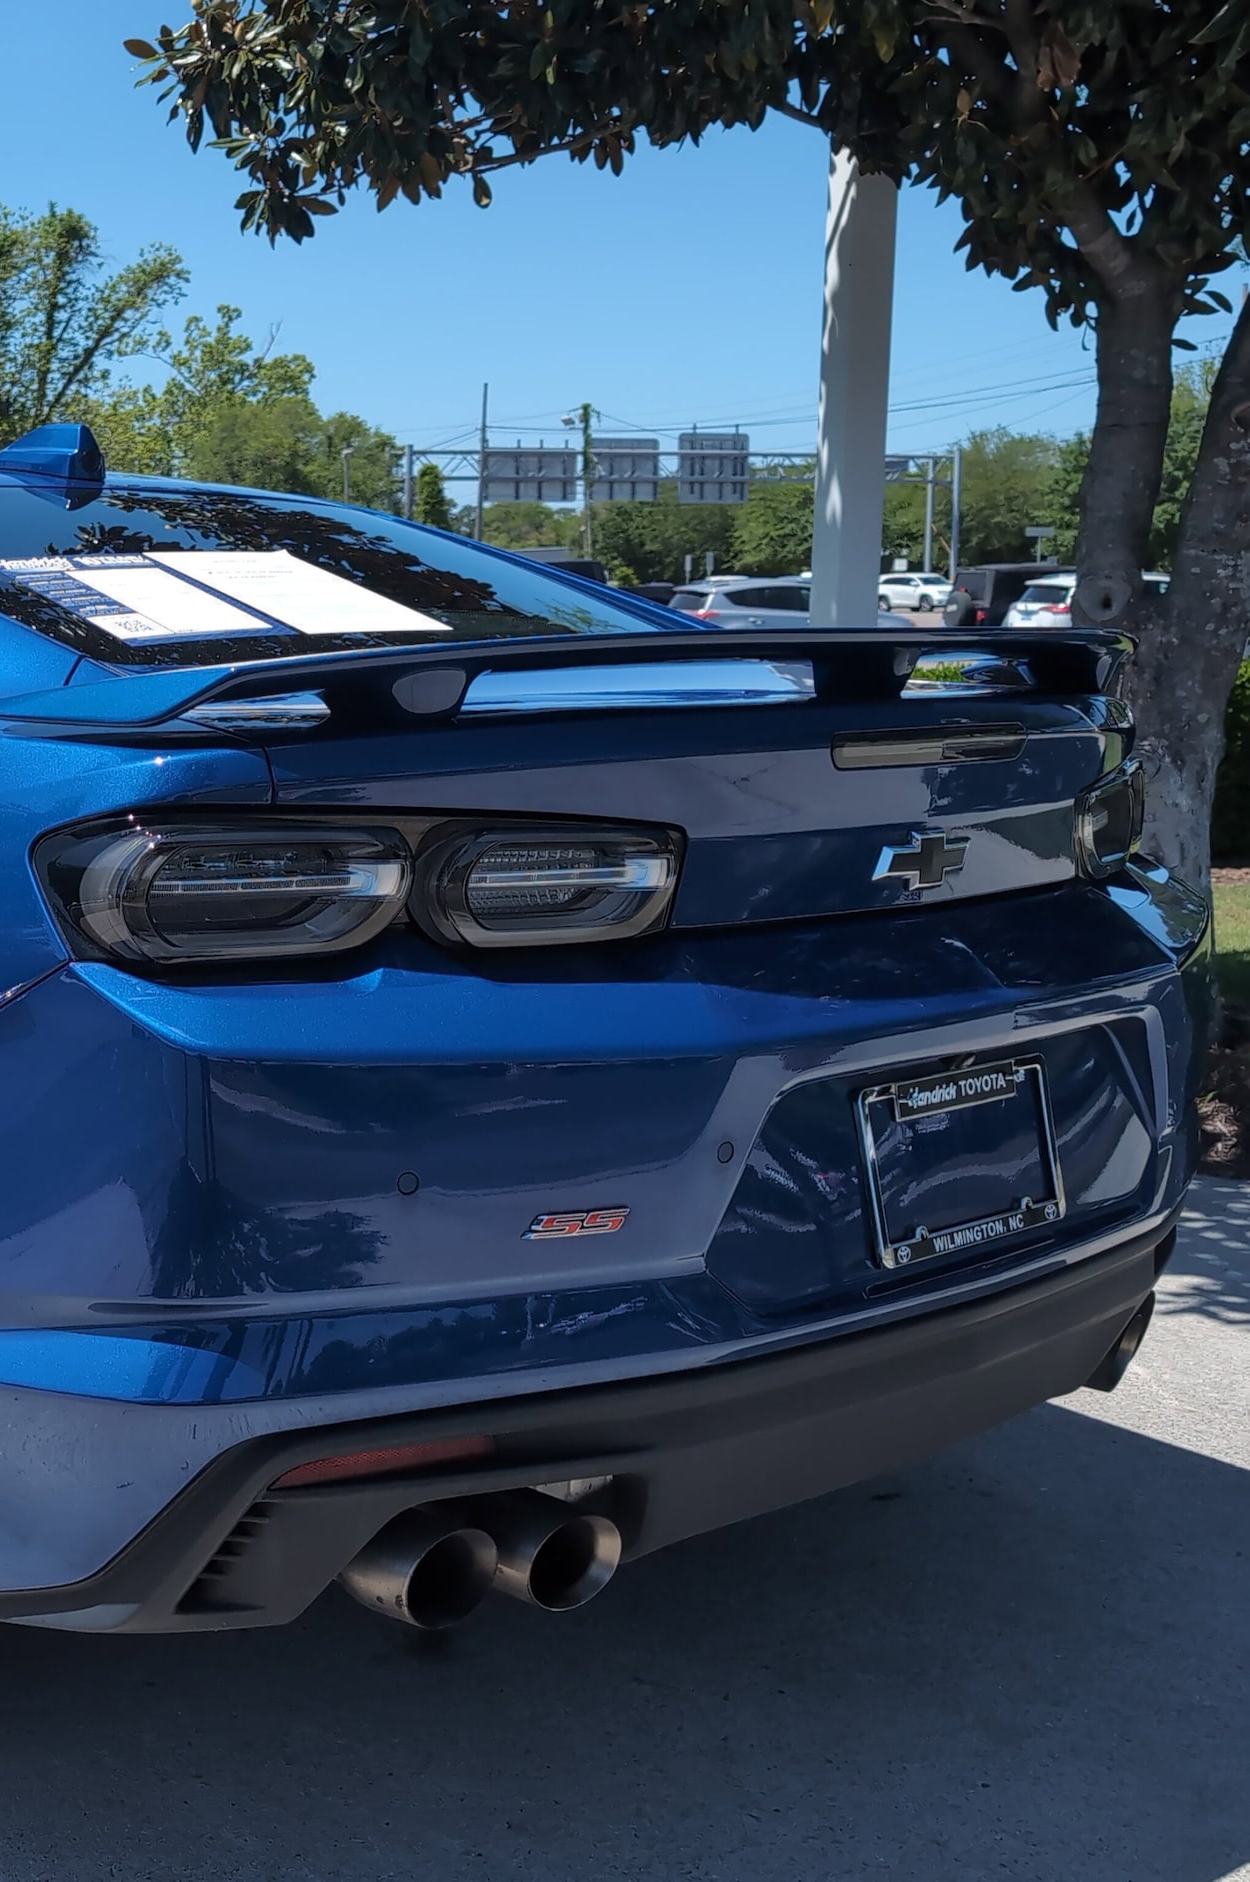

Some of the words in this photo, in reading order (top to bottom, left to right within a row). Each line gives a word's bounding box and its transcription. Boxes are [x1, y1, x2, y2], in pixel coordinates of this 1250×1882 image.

[959, 1073, 1006, 1097] TOYOTA
[521, 1207, 630, 1240] SS
[932, 1219, 1008, 1253] WILMINGTON,
[1008, 1214, 1025, 1231] NC
